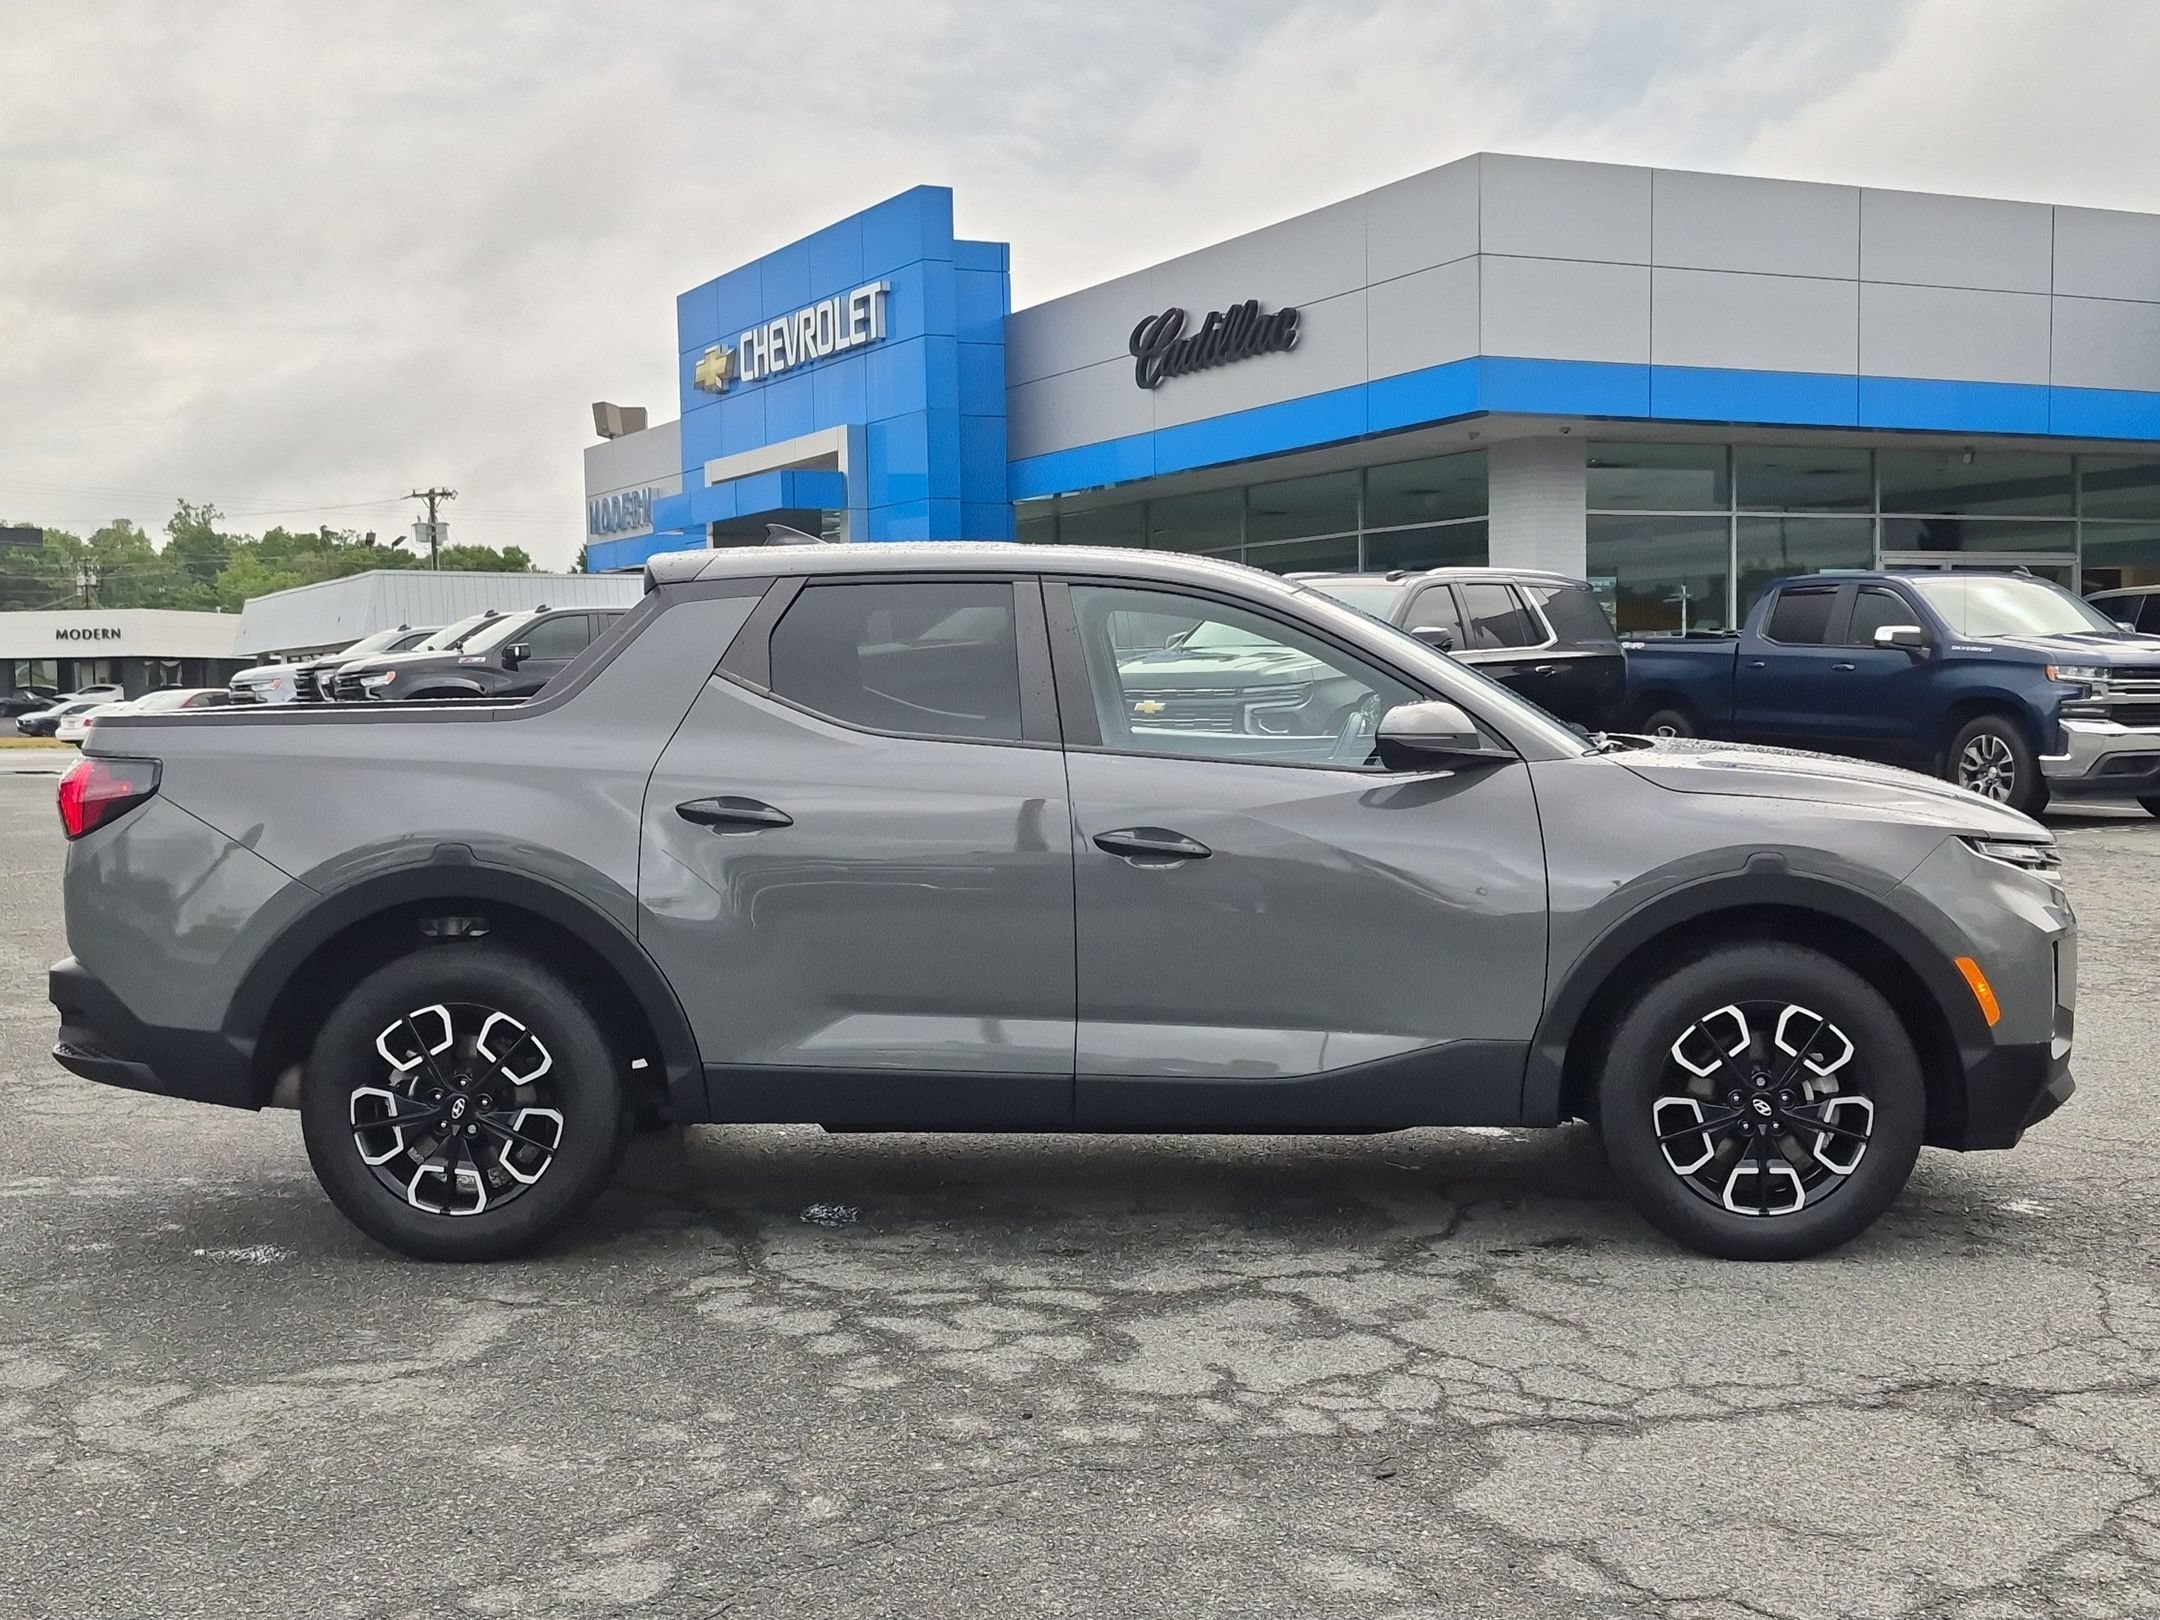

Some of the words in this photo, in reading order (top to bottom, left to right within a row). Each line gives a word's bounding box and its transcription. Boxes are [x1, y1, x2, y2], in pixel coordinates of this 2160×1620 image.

[739, 281, 885, 382] CHEVROLET
[1129, 300, 1298, 389] Cadillac
[589, 488, 653, 535] MODERN
[56, 628, 121, 640] MODERN
